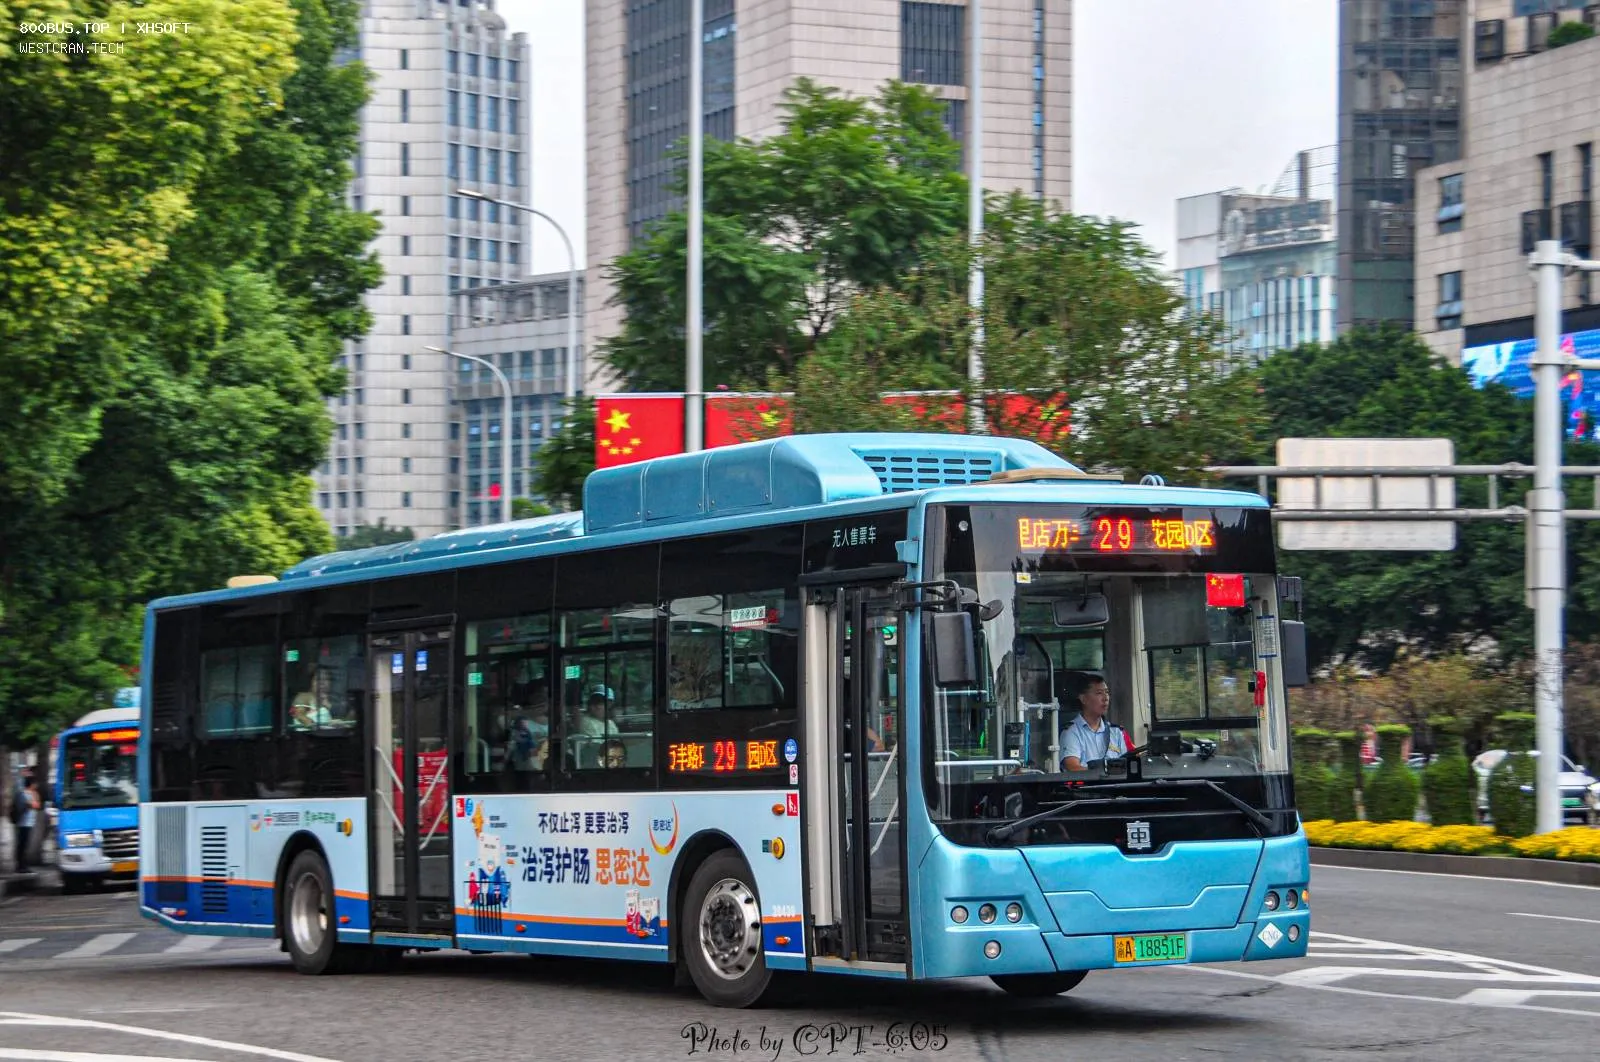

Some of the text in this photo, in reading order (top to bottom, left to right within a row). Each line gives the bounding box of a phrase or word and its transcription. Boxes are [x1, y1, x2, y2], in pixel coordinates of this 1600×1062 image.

[832, 525, 877, 548] 无人售票车
[1098, 519, 1132, 549] 29
[714, 740, 737, 771] 29
[538, 811, 629, 834] 不仅止泻 更要治泻
[652, 819, 672, 832] 思密达
[522, 846, 651, 887] 治泻护肠 思密达
[1139, 937, 1184, 957] 18851F
